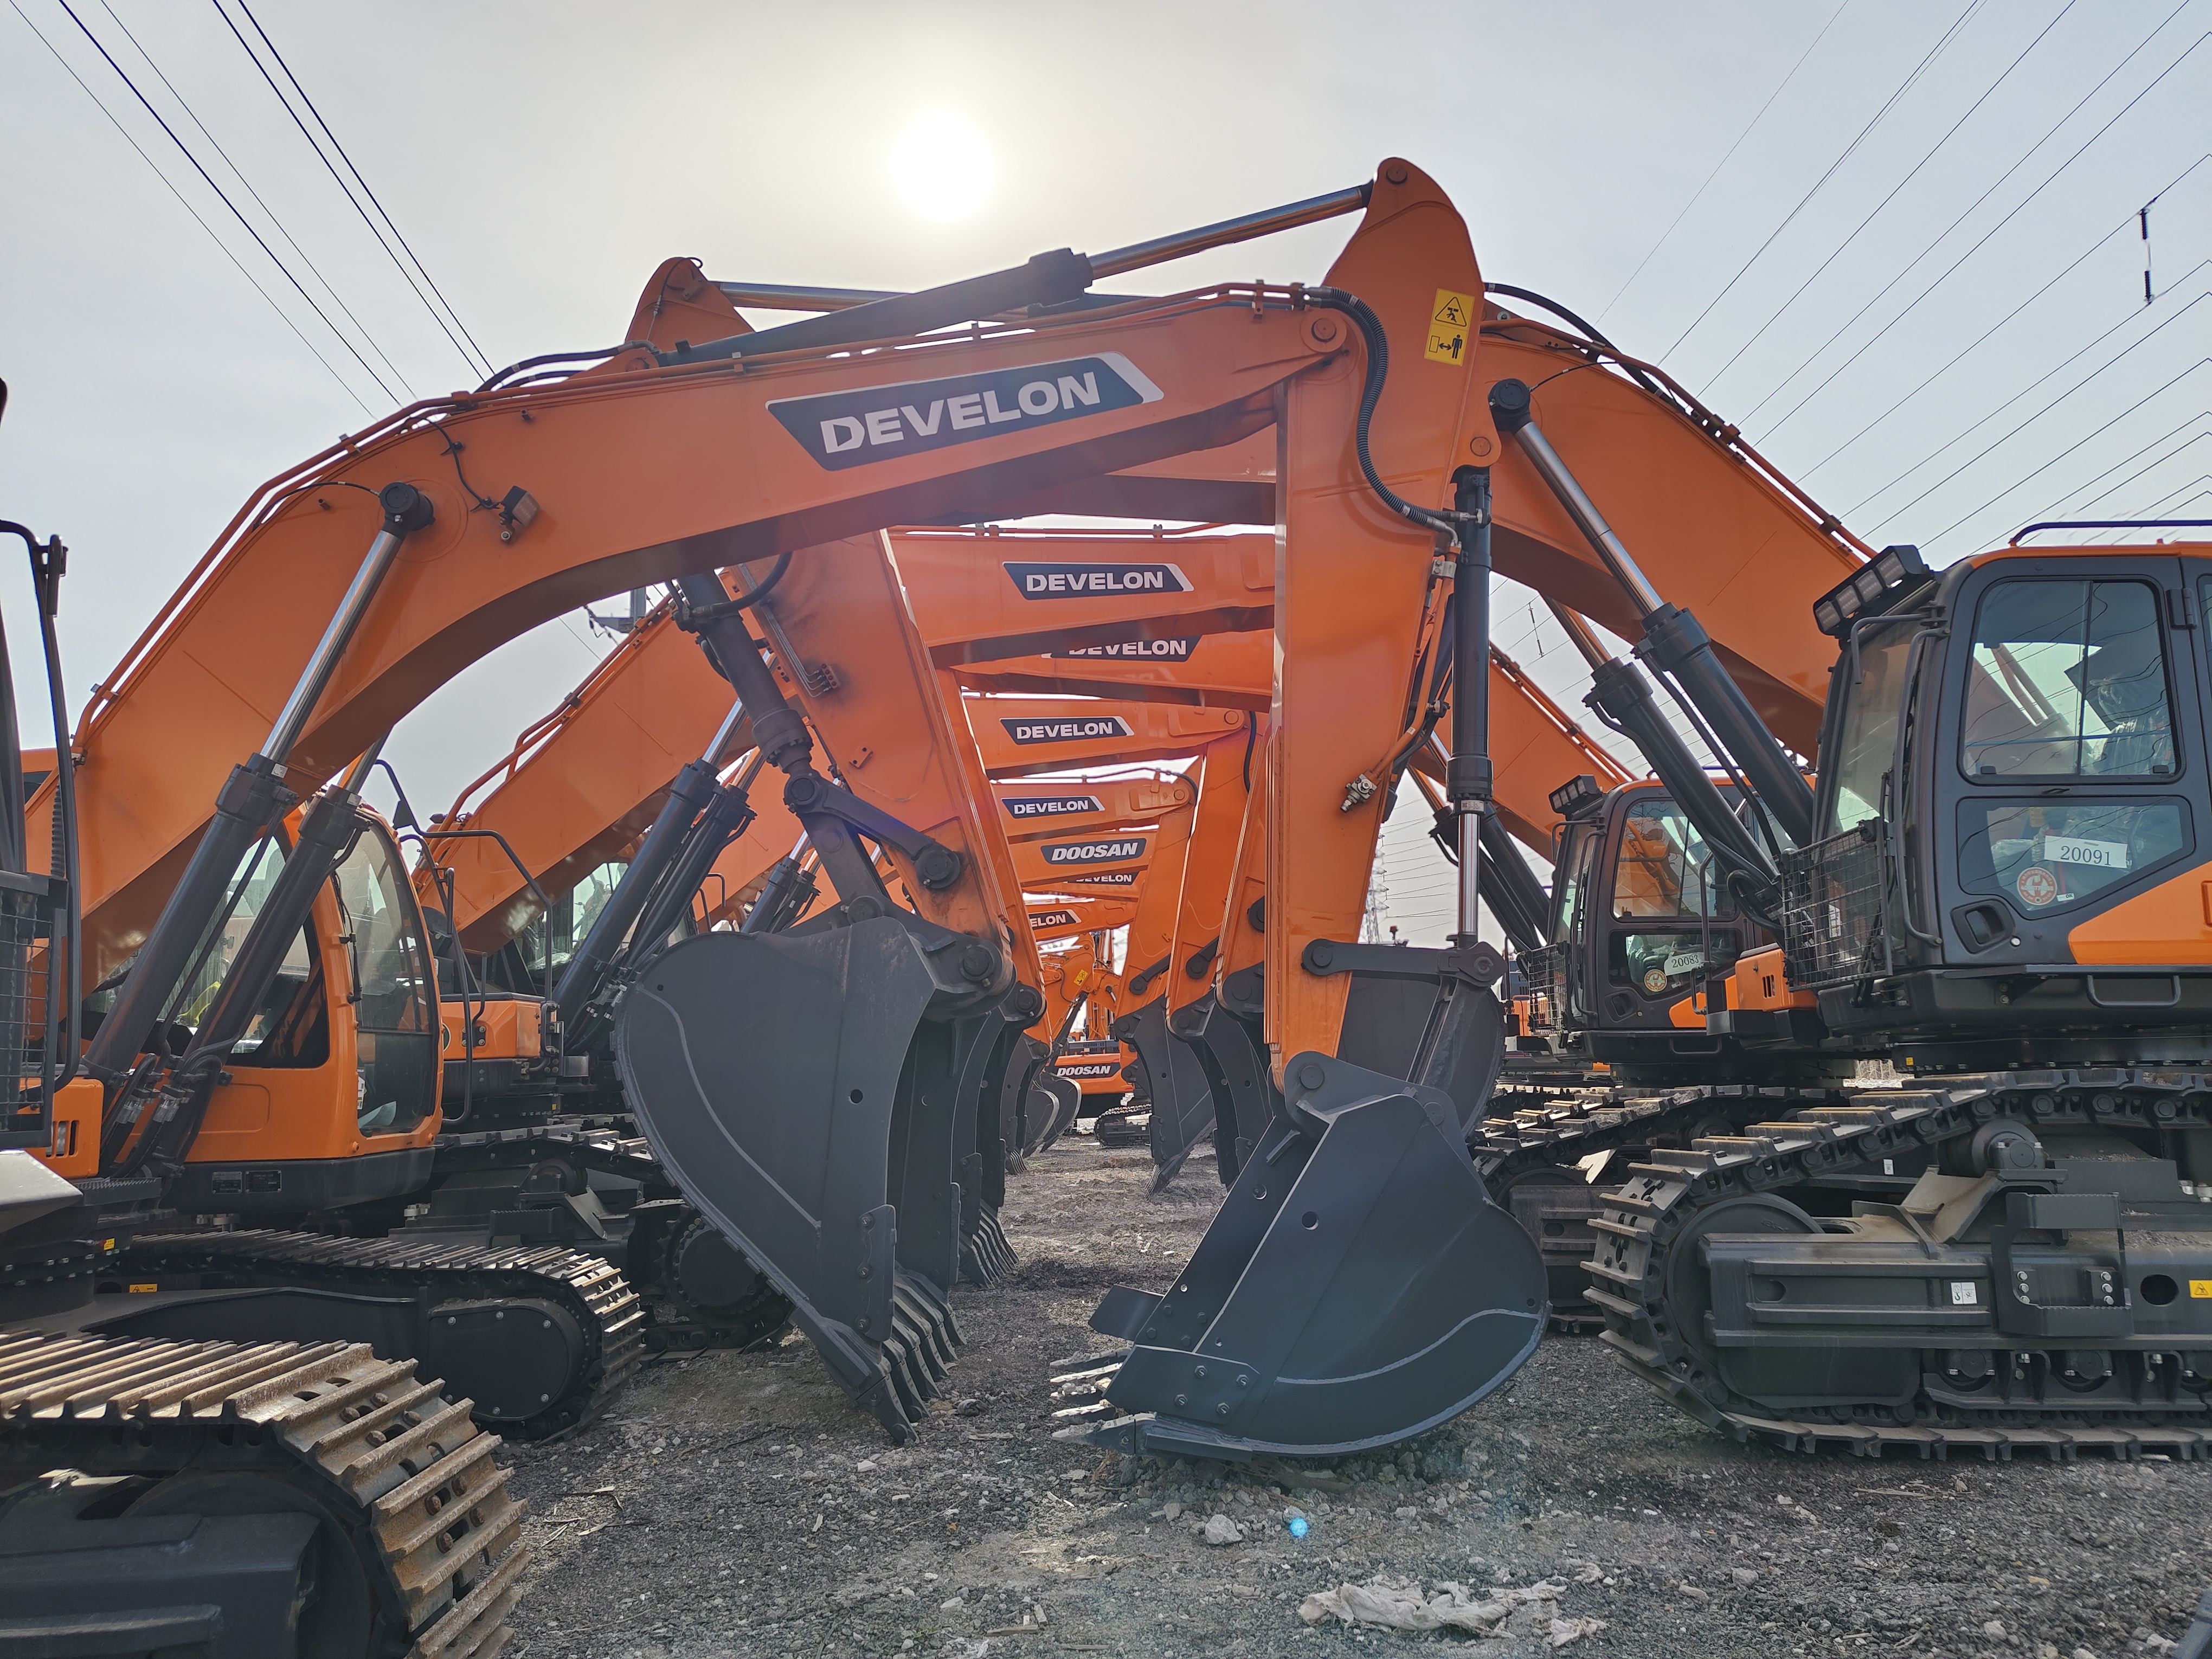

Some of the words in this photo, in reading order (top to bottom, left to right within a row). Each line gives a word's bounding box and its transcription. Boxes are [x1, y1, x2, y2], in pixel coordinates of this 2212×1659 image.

[819, 370, 1101, 454] DEVELON
[1026, 571, 1163, 591] DEVELON
[1017, 722, 1113, 740] DEVELON
[1014, 800, 1089, 814] DEVELON
[1051, 842, 1139, 861] DOOSAN
[2060, 845, 2112, 866] 20091
[1029, 914, 1066, 927] ELON
[1671, 954, 1699, 968] 20083
[1057, 1065, 1111, 1076] DOOSAN
